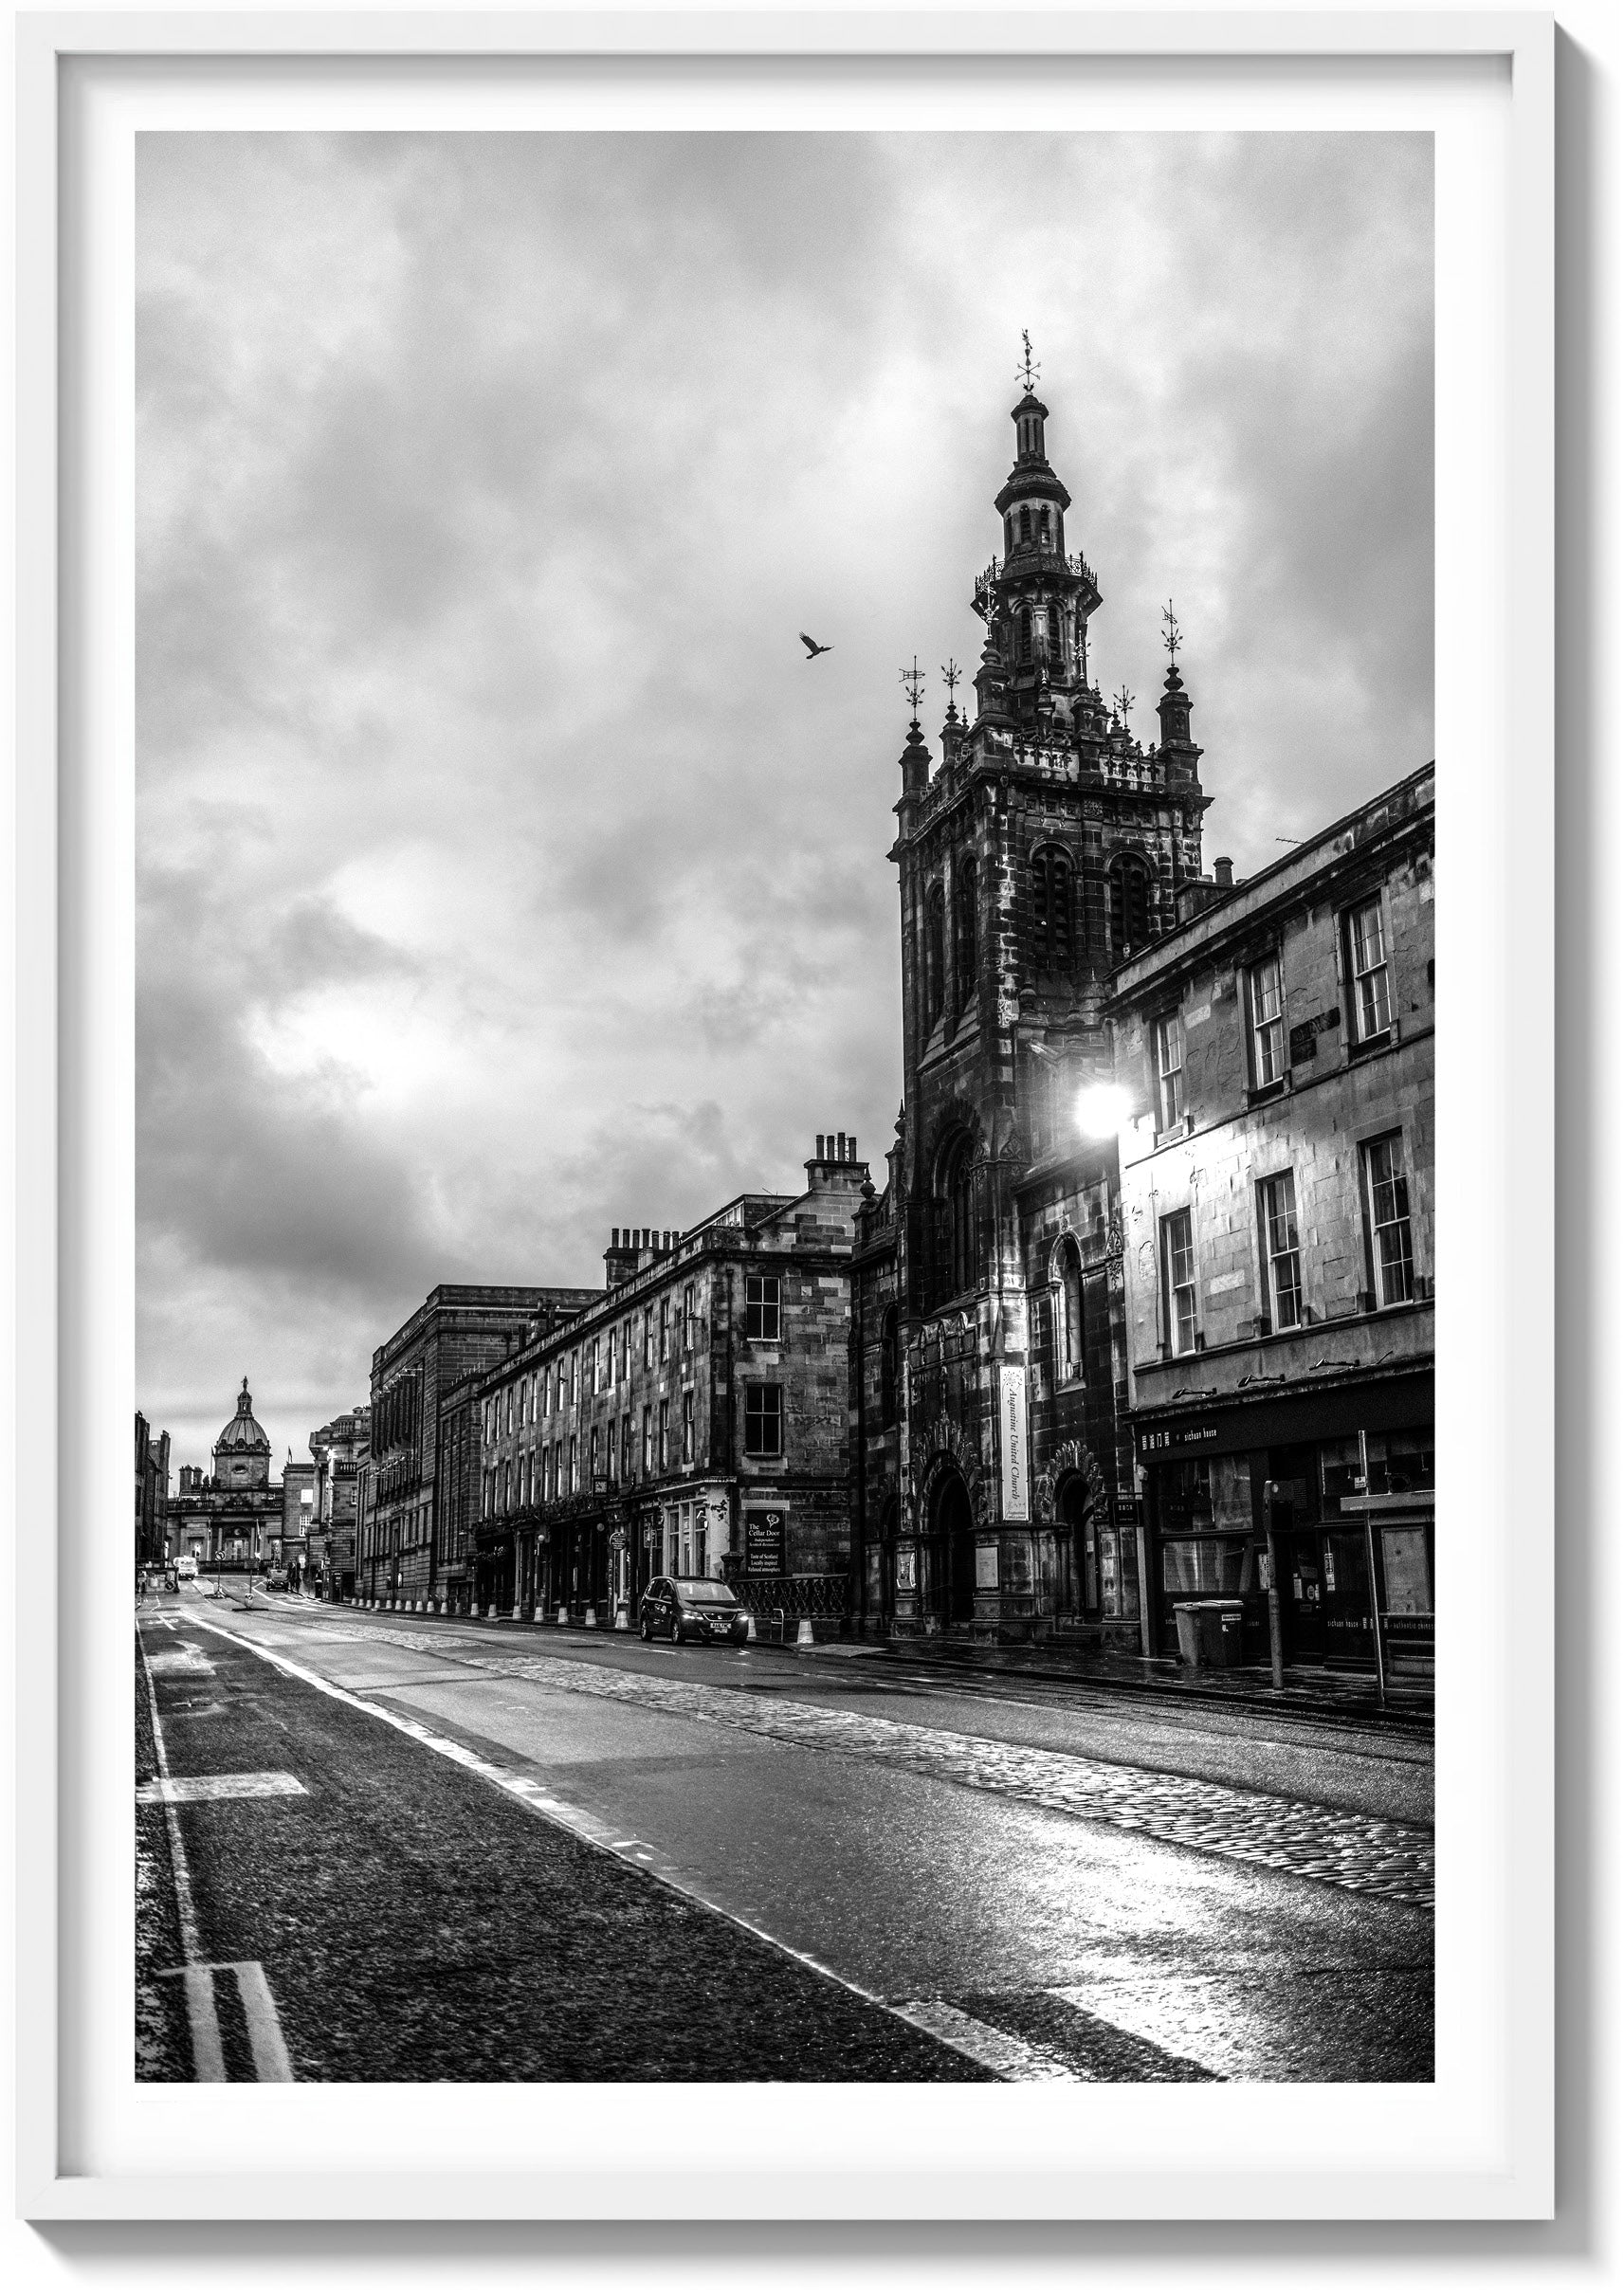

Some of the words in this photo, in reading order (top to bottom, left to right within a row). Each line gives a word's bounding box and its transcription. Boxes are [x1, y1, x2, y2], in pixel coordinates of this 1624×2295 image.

[1007, 1388, 1018, 1432] Augustine
[1009, 1434, 1019, 1465] United
[1184, 1430, 1202, 1442] sichuan
[1203, 1428, 1217, 1438] house
[1011, 1466, 1021, 1500] Church
